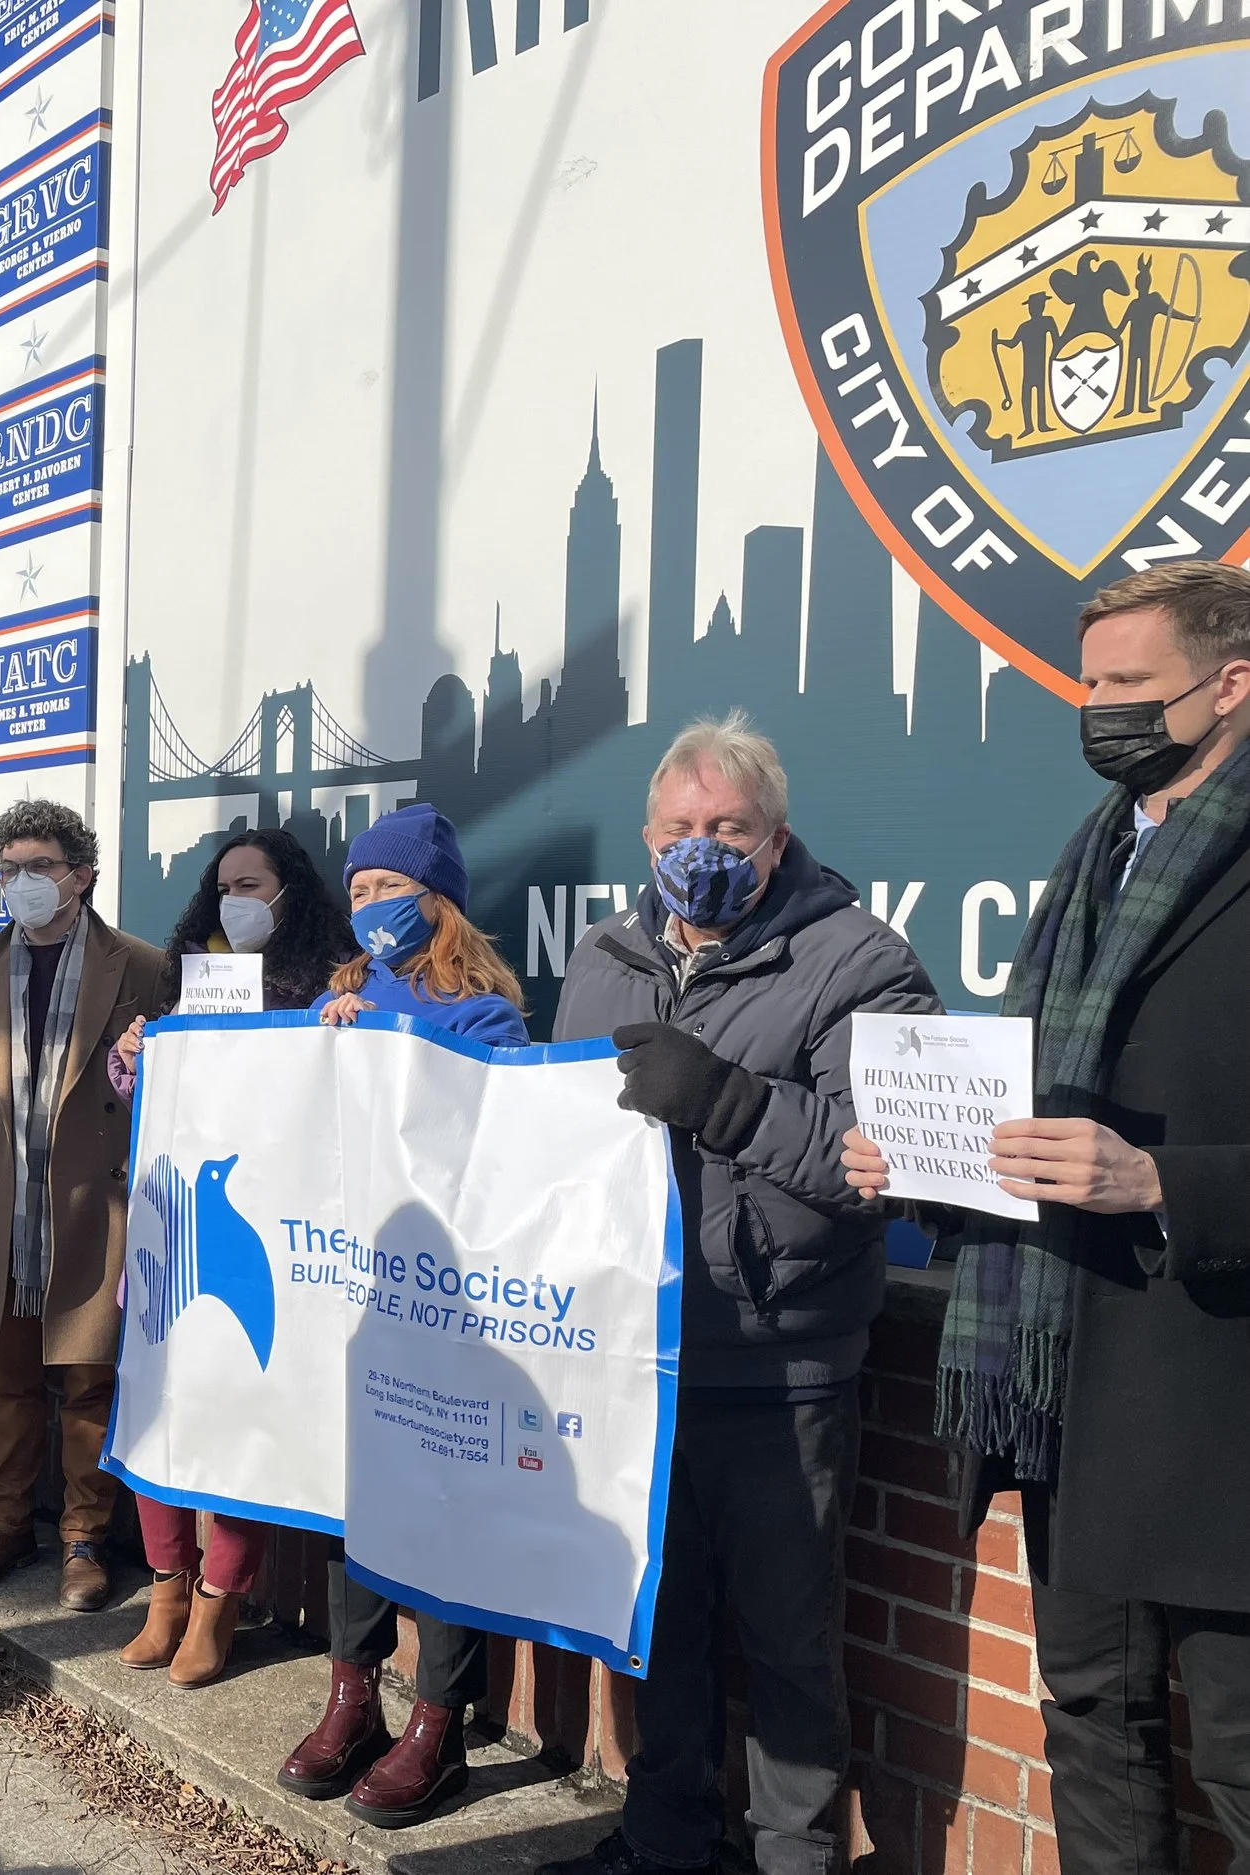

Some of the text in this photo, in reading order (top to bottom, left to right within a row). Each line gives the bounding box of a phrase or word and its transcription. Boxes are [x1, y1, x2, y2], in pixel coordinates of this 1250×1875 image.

[4, 19, 26, 46] ERIC
[21, 11, 59, 48] CENTER
[806, 0, 1004, 133] COR
[43, 218, 82, 248] VIERNO
[16, 249, 54, 279] CENTER
[820, 312, 1250, 572] CITY OF NE
[23, 472, 33, 487] N.
[34, 454, 81, 482] DAVOREN
[12, 483, 50, 506] CENTER
[19, 705, 28, 718] A.
[30, 697, 70, 716] THOMAS
[9, 718, 46, 735] CENTER
[527, 884, 646, 977] NE
[185, 987, 251, 1000] HUMANITY AND
[864, 1068, 1007, 1098] HUMANITY AND
[875, 1096, 996, 1126] DIGNITY FOR
[859, 1122, 918, 1145] THOSE
[888, 1152, 912, 1170] AT
[280, 1218, 345, 1254] The
[415, 1252, 576, 1323] Society
[410, 1300, 457, 1331] NOT
[461, 1312, 597, 1352] PRISONS
[365, 1383, 384, 1401] Long
[386, 1391, 414, 1408] Island
[436, 1407, 450, 1420] NY
[452, 1412, 488, 1426] 11101
[368, 1369, 489, 1410] 29-76 Northern Boulevard
[374, 1408, 489, 1449] www.fortunesociety.org
